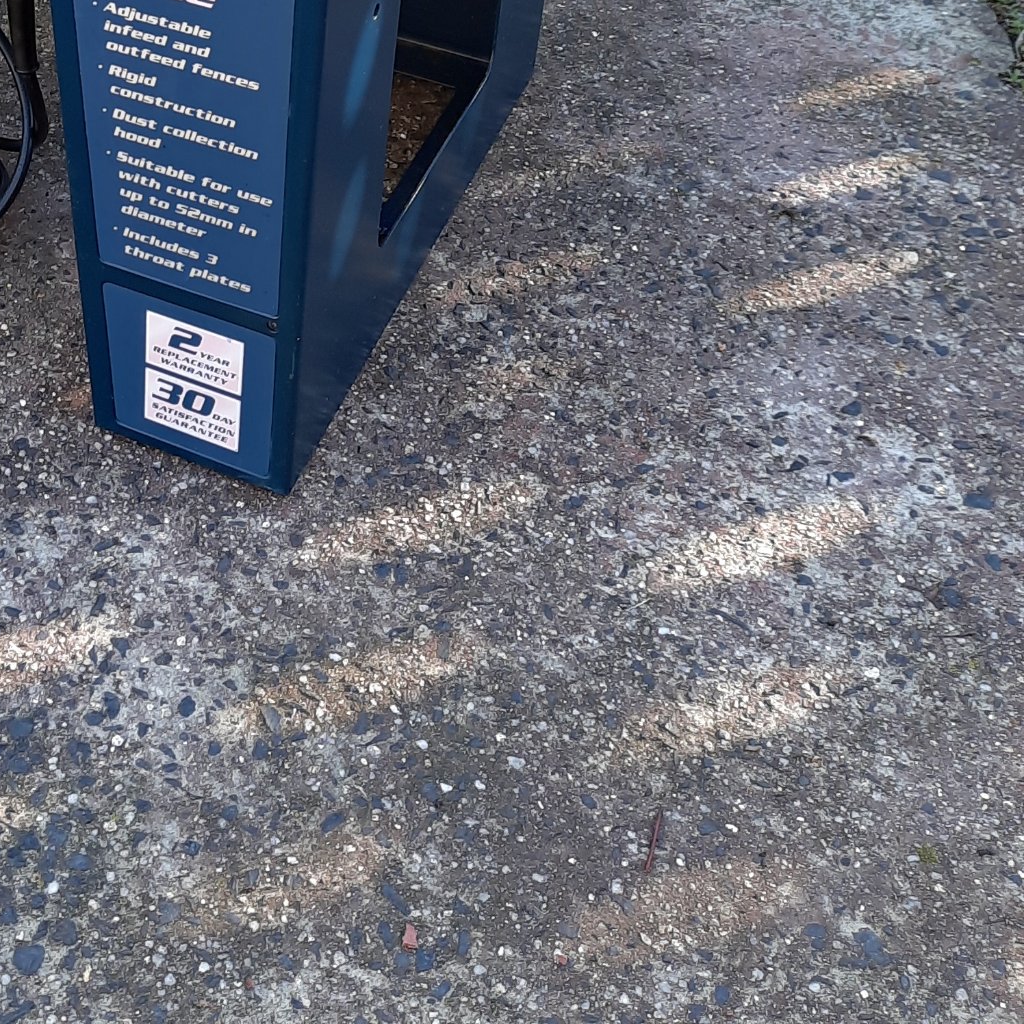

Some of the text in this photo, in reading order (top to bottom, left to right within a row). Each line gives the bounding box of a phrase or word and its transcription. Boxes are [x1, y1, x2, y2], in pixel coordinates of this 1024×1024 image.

[103, 2, 211, 39] Adjustable
[103, 20, 211, 58] infeed and
[106, 41, 260, 91] outfeed fences
[108, 64, 157, 88] Rigid
[110, 85, 236, 128] construction
[112, 108, 259, 160] Dust collection
[113, 126, 161, 149] hood
[116, 151, 273, 207] Suitable for use
[118, 170, 240, 215] with cutters
[120, 187, 257, 237] up to 52mm in
[121, 205, 207, 238] diameter
[123, 227, 219, 265] Includes 3
[124, 245, 252, 293] throat plates
[153, 345, 237, 379] REPLACEMENT
[168, 326, 231, 367] 2 YEAR
[160, 357, 229, 385] WARRANTY
[152, 378, 236, 426] 30 DAY
[152, 402, 236, 438] SATISFACTION
[155, 412, 229, 443] GUARANTEE
